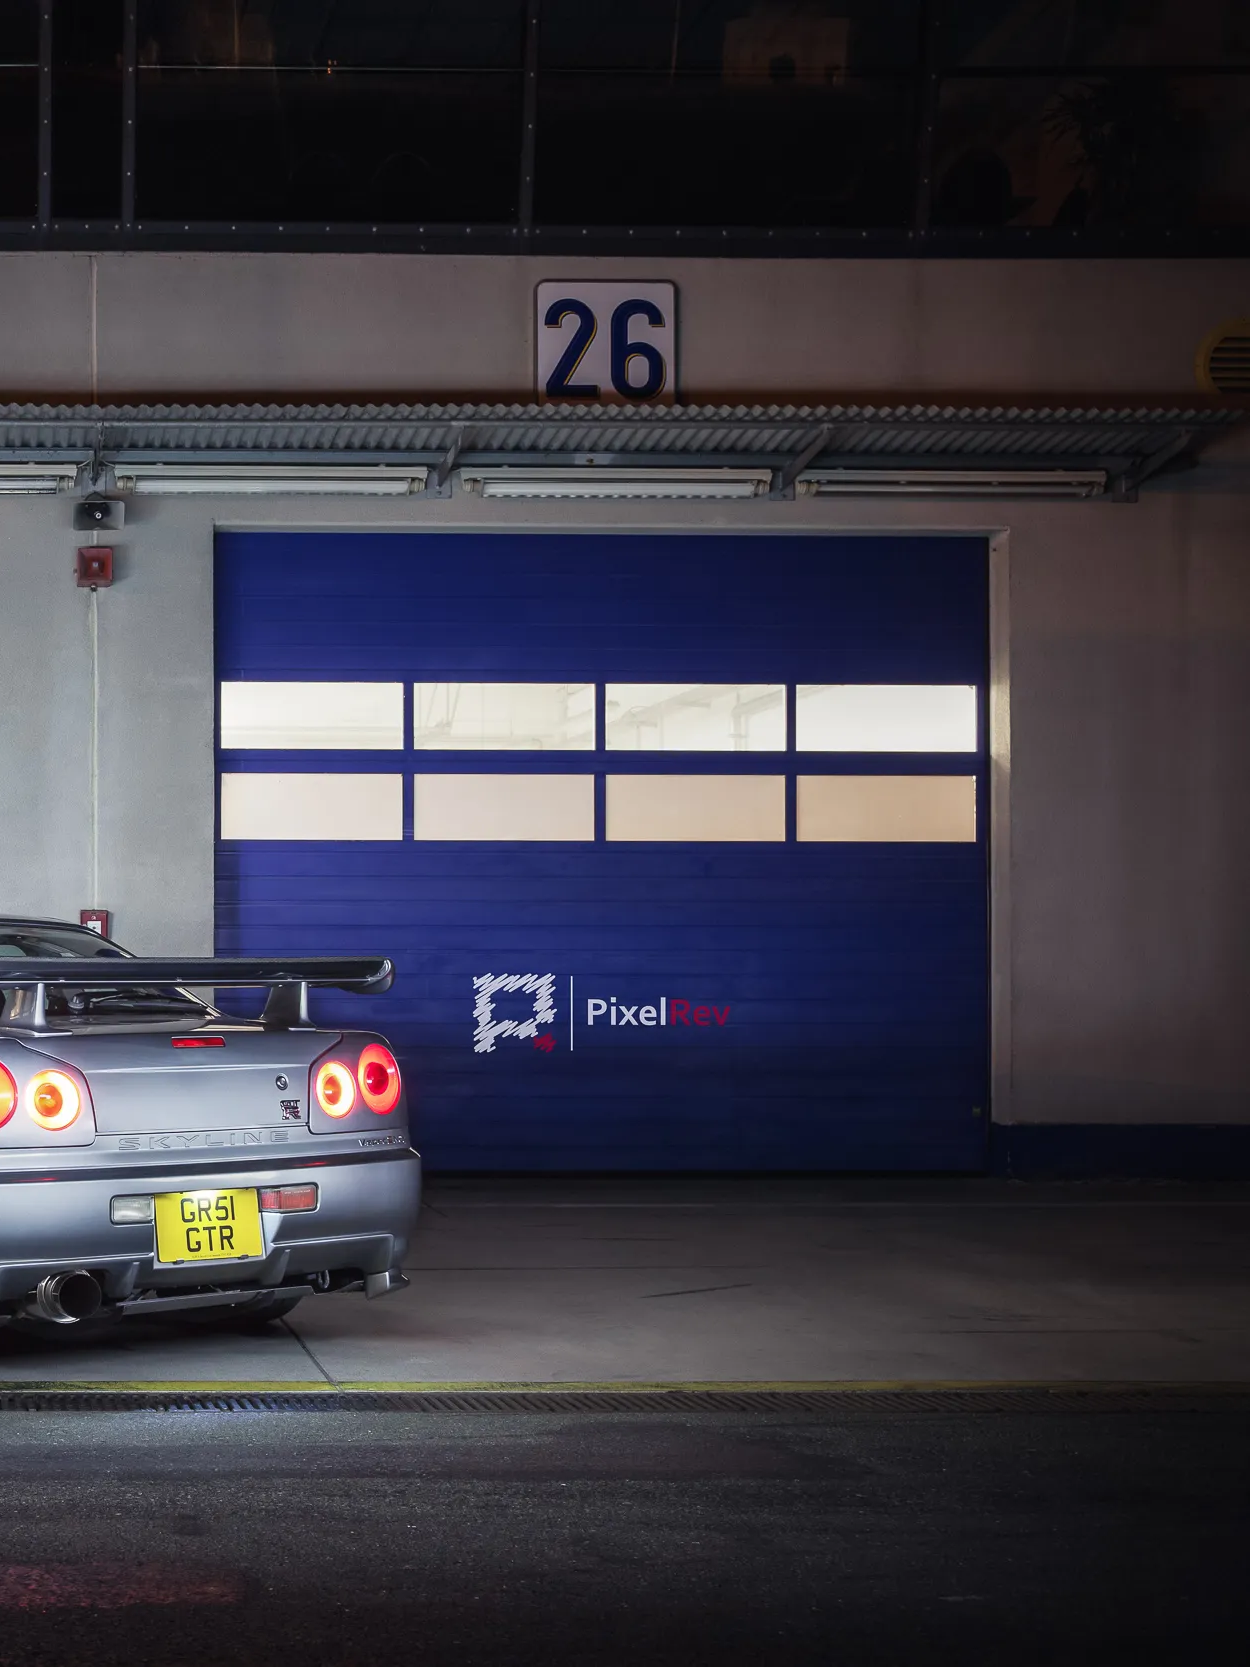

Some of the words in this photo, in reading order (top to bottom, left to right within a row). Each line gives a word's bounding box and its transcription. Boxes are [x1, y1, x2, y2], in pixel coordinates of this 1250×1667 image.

[544, 298, 667, 400] 26
[119, 1130, 289, 1150] SKYLINE
[180, 1196, 235, 1223] GR51
[186, 1225, 234, 1252] GTR
